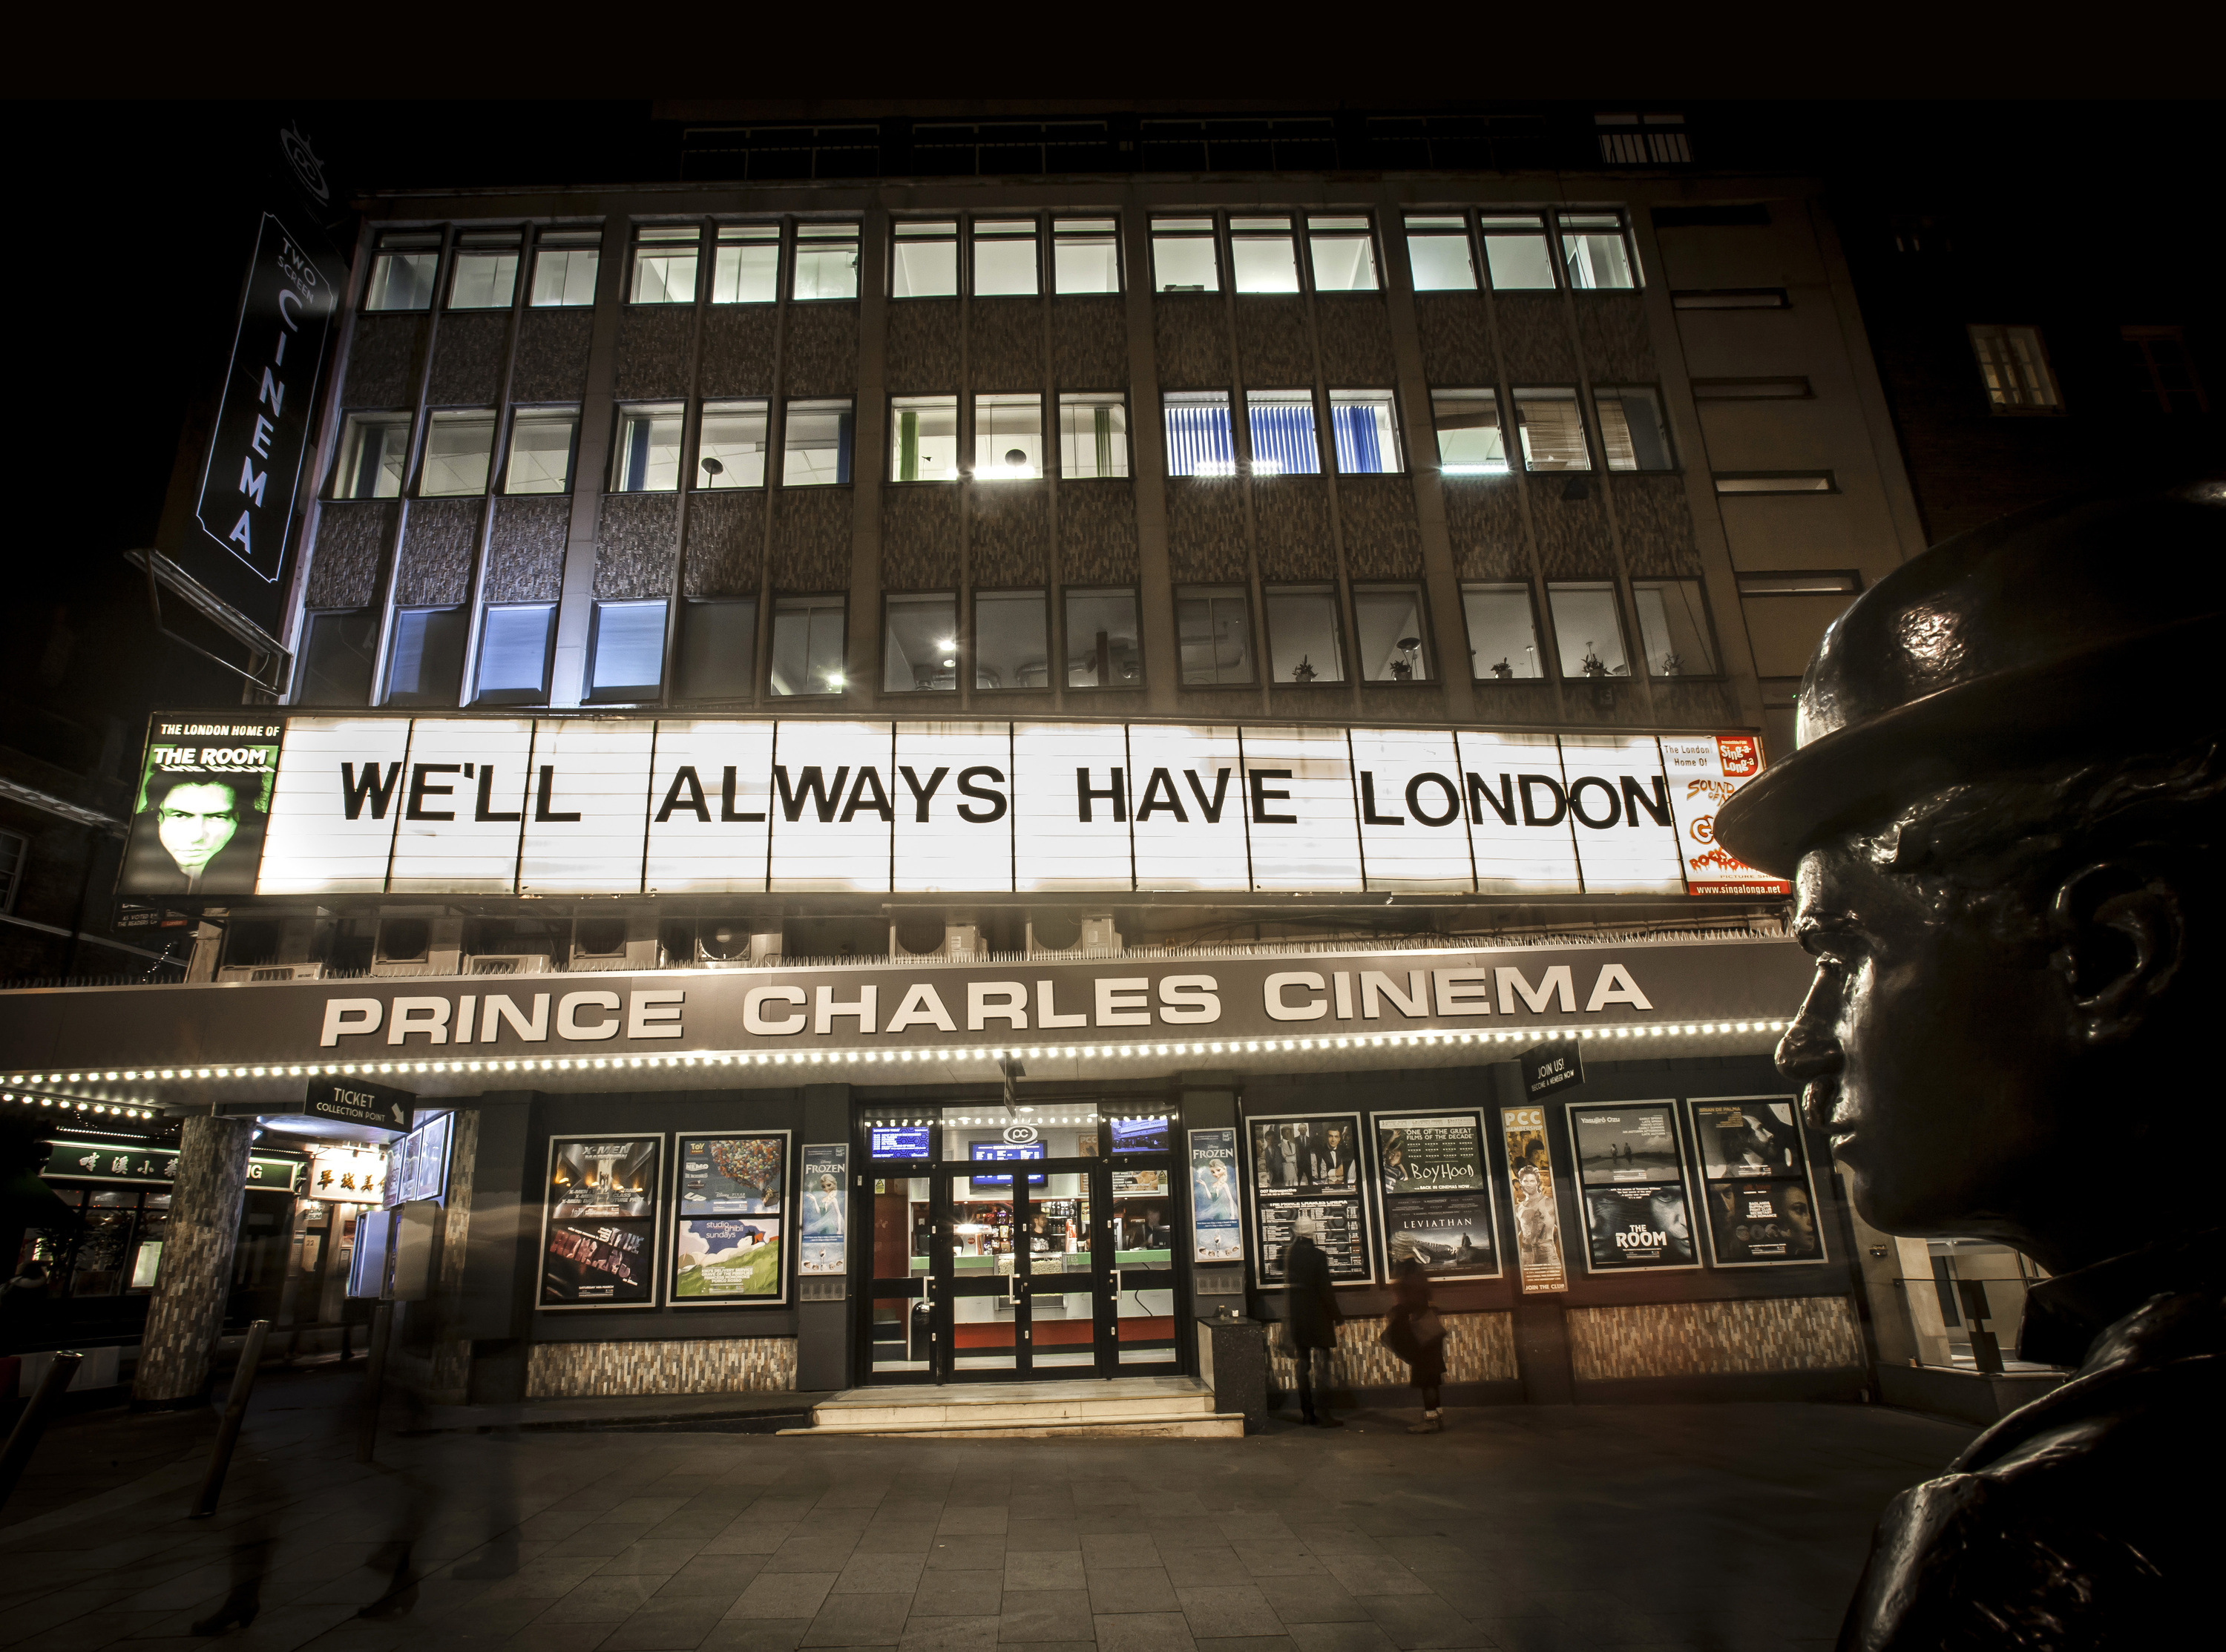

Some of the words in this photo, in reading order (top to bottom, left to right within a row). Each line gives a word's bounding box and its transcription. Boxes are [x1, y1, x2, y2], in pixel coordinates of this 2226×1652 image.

[282, 237, 316, 287] TWO
[278, 254, 315, 305] SCREEN
[229, 289, 302, 555] CINEMA
[161, 724, 183, 735] THE
[183, 724, 229, 736] LONDON
[231, 725, 263, 736] HOME
[264, 726, 280, 737] OF
[1664, 745, 1679, 754] The
[1681, 746, 1710, 754] London
[154, 748, 197, 766] THE
[200, 748, 267, 766] ROOM
[1674, 758, 1696, 766] Home
[1698, 757, 1707, 766] Of
[341, 761, 582, 823] WE'LL
[654, 766, 1008, 823] ALWAYS
[1076, 767, 1298, 824] HAVE
[1360, 771, 1672, 827] LONDON
[1687, 779, 1735, 801] SOUND
[1708, 792, 1719, 801] OF
[1696, 883, 1782, 895] www.singalonga.net
[320, 990, 685, 1047] PRINCE
[742, 975, 1221, 1037] CHARLES
[1264, 963, 1654, 1021] CINEMA
[1537, 1062, 1553, 1079] JOIN
[1554, 1057, 1565, 1073] US!
[1563, 1069, 1575, 1079] NOW
[334, 1087, 375, 1108] TICKET
[316, 1102, 364, 1119] COLLECTION
[365, 1111, 386, 1122] POINT
[1504, 1111, 1542, 1126] PCC
[582, 1145, 630, 1155] X-MEN
[1192, 1148, 1233, 1160] FROZEN
[805, 1163, 845, 1175] FROZEN
[706, 1220, 729, 1228] studio
[724, 1224, 744, 1233] ghibli
[1404, 1218, 1472, 1229] LEVIATHAN
[1629, 1224, 1646, 1233] THE
[706, 1231, 736, 1240] sundays
[1615, 1231, 1667, 1248] ROOM
[306, 1239, 315, 1247] 22
